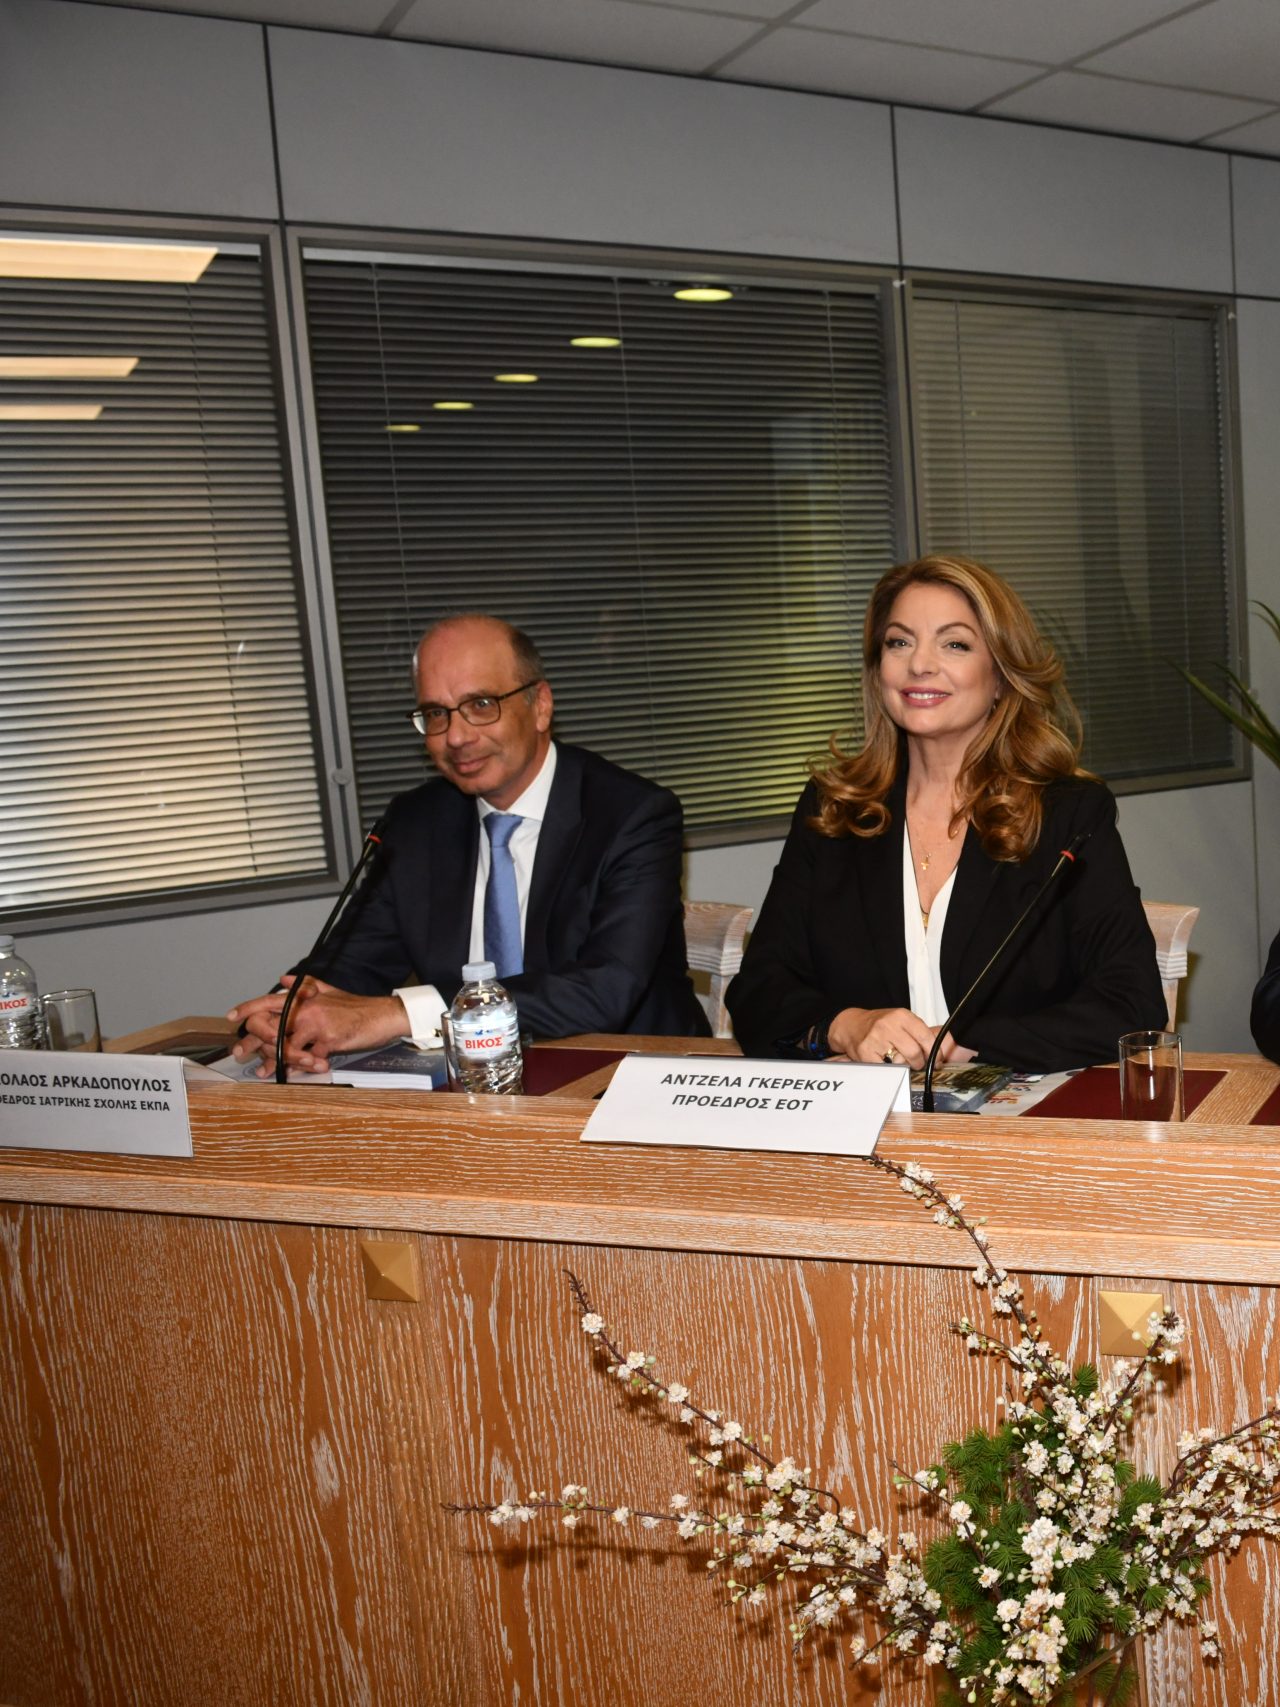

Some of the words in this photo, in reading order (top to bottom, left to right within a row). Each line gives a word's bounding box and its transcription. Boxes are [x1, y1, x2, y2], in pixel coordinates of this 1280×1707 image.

[465, 1037, 503, 1049] ΒΙΚΟΣ
[0, 1073, 48, 1087] ΟΛΑΟΣ
[53, 1075, 171, 1092] ΑΡΚΑΔΟΠΟΥΛΟΣ
[661, 1073, 742, 1088] ΑΝΤΖΕΛΑ
[748, 1077, 844, 1092] ΓΚΕΡΕΚΟΥ
[39, 1096, 91, 1108] ΙΑΤΡΙΚΗΣ
[94, 1099, 137, 1110] ΣΧΟΛΗΣ
[140, 1101, 170, 1111] ΕΚΠΑ
[672, 1094, 771, 1109] ΠΡΟΕΔΡΟΣ
[775, 1099, 813, 1111] ΕΟΤ
